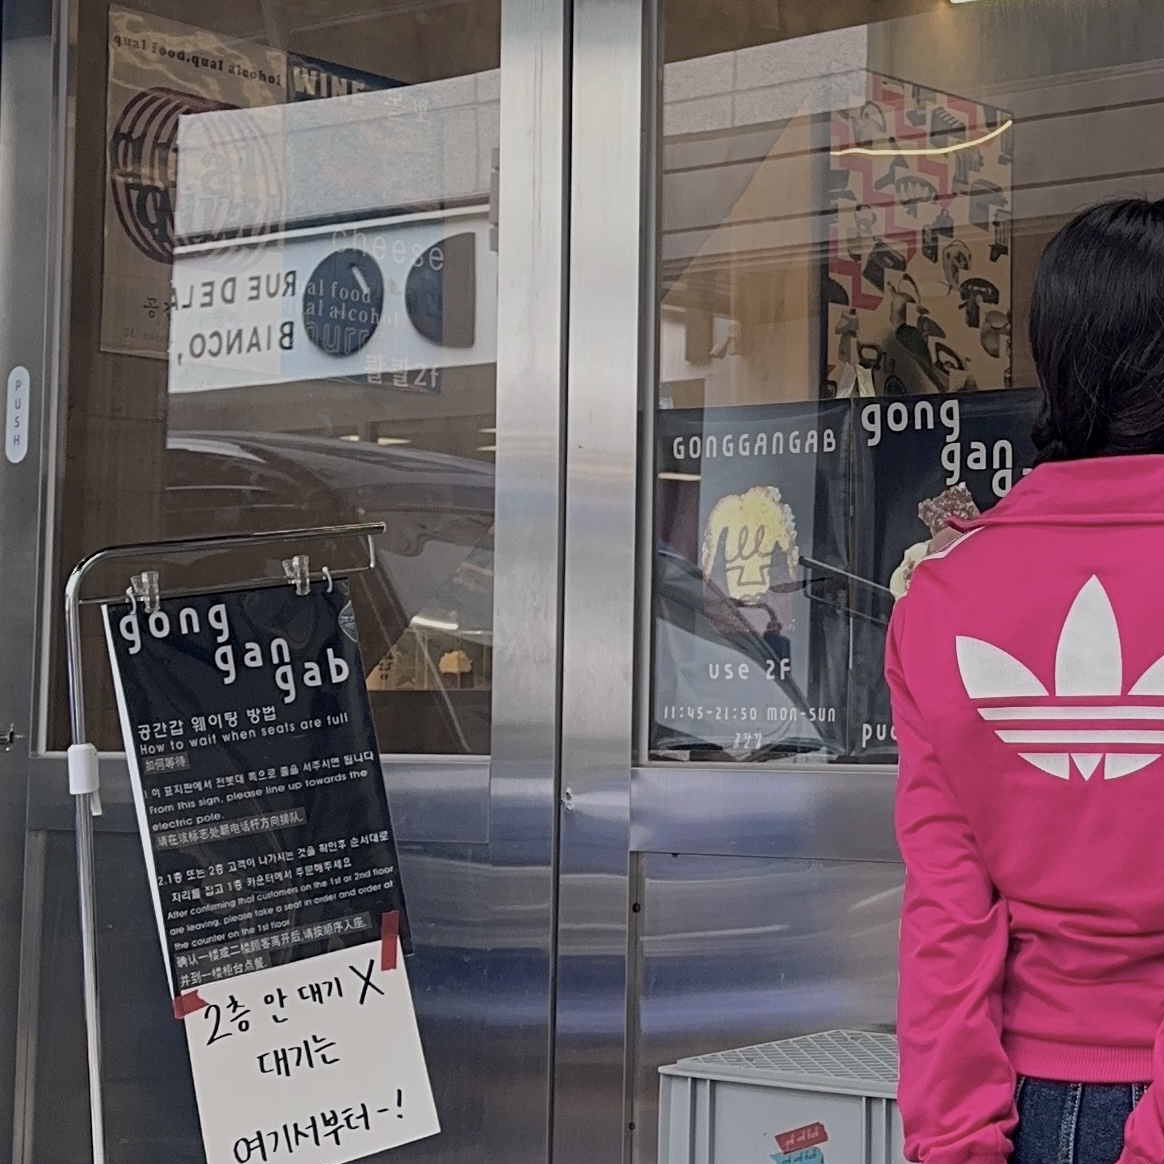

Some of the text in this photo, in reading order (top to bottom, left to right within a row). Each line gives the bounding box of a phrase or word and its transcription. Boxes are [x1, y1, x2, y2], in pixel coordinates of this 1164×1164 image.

[331, 226, 444, 271] cheese
[330, 281, 372, 304] food
[329, 302, 399, 328] alcohol
[13, 379, 22, 447] PUSH
[861, 399, 960, 447] gong
[672, 428, 837, 460] GONGGANGAB
[940, 438, 1014, 486] gan
[119, 603, 230, 655] gong
[214, 637, 292, 685] gan
[274, 648, 350, 704] gab
[708, 657, 791, 681] use 2F
[137, 706, 277, 741] 공간갑 웨이팅 방법
[140, 712, 349, 756] How to wait when seats are full
[663, 705, 758, 721] 11:45-21:50
[149, 803, 175, 815] From
[177, 798, 197, 811] this
[226, 789, 263, 803] please
[265, 783, 286, 795] line
[288, 781, 303, 792] up
[304, 772, 347, 789] towards
[348, 769, 369, 780] the
[152, 816, 193, 833] electric
[167, 909, 188, 921] After
[299, 883, 312, 892] on
[203, 959, 385, 1046] 2층 안 대기 X
[256, 1034, 340, 1077] 대기는
